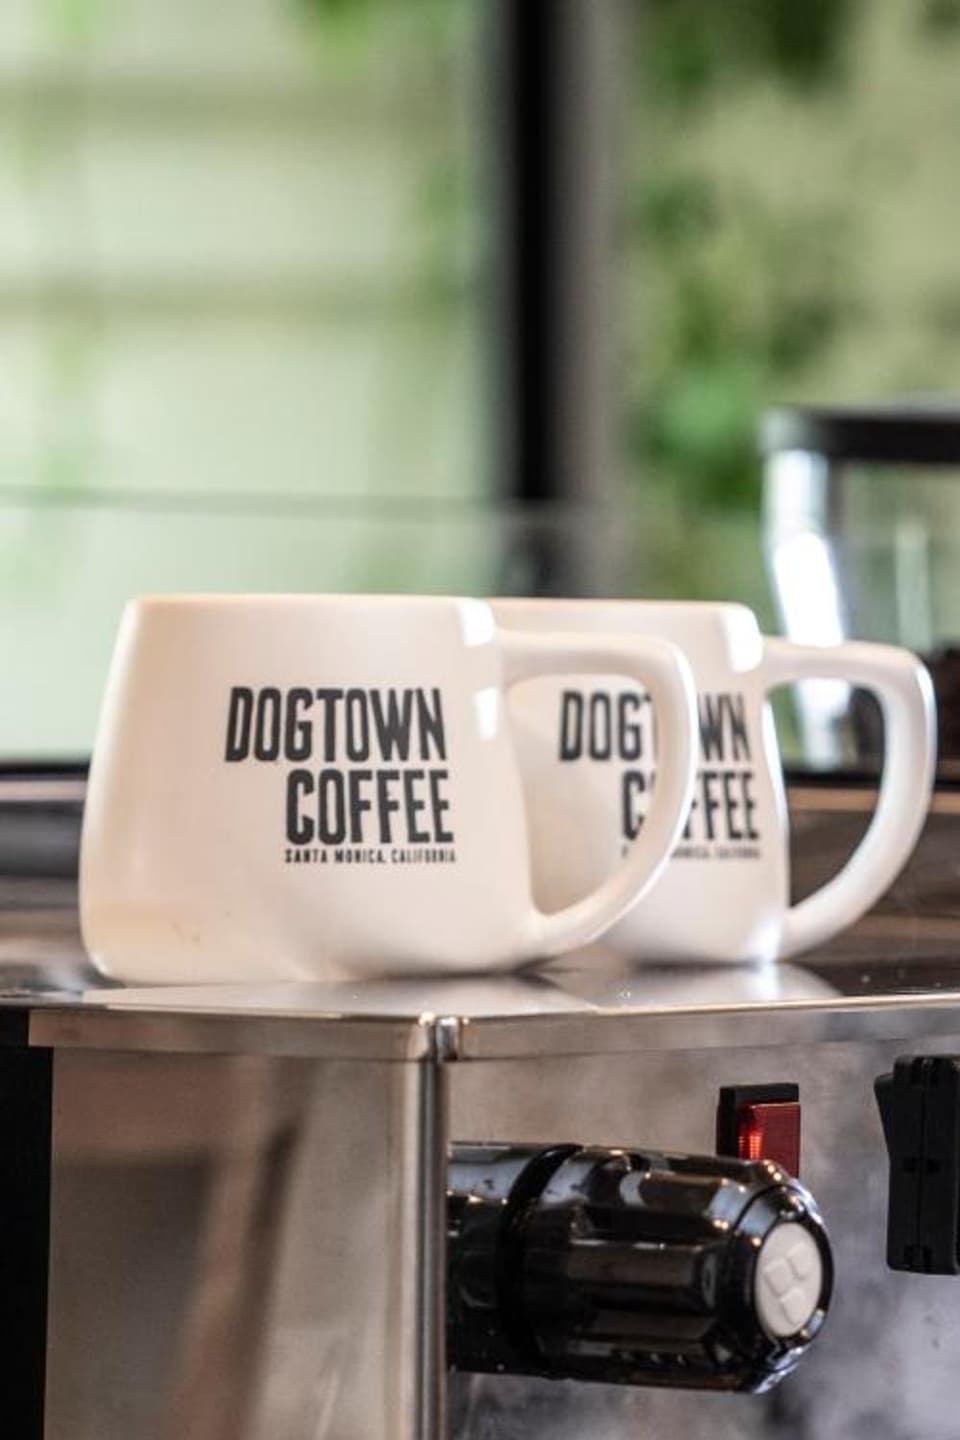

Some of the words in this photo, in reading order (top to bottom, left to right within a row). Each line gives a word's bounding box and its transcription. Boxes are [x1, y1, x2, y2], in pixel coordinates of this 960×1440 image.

[225, 687, 447, 763] DOGTOWN
[559, 690, 752, 763] DOGWN
[286, 768, 454, 845] COFFEE
[285, 849, 328, 863] SANTA
[391, 849, 456, 863] CALIFORNIA
